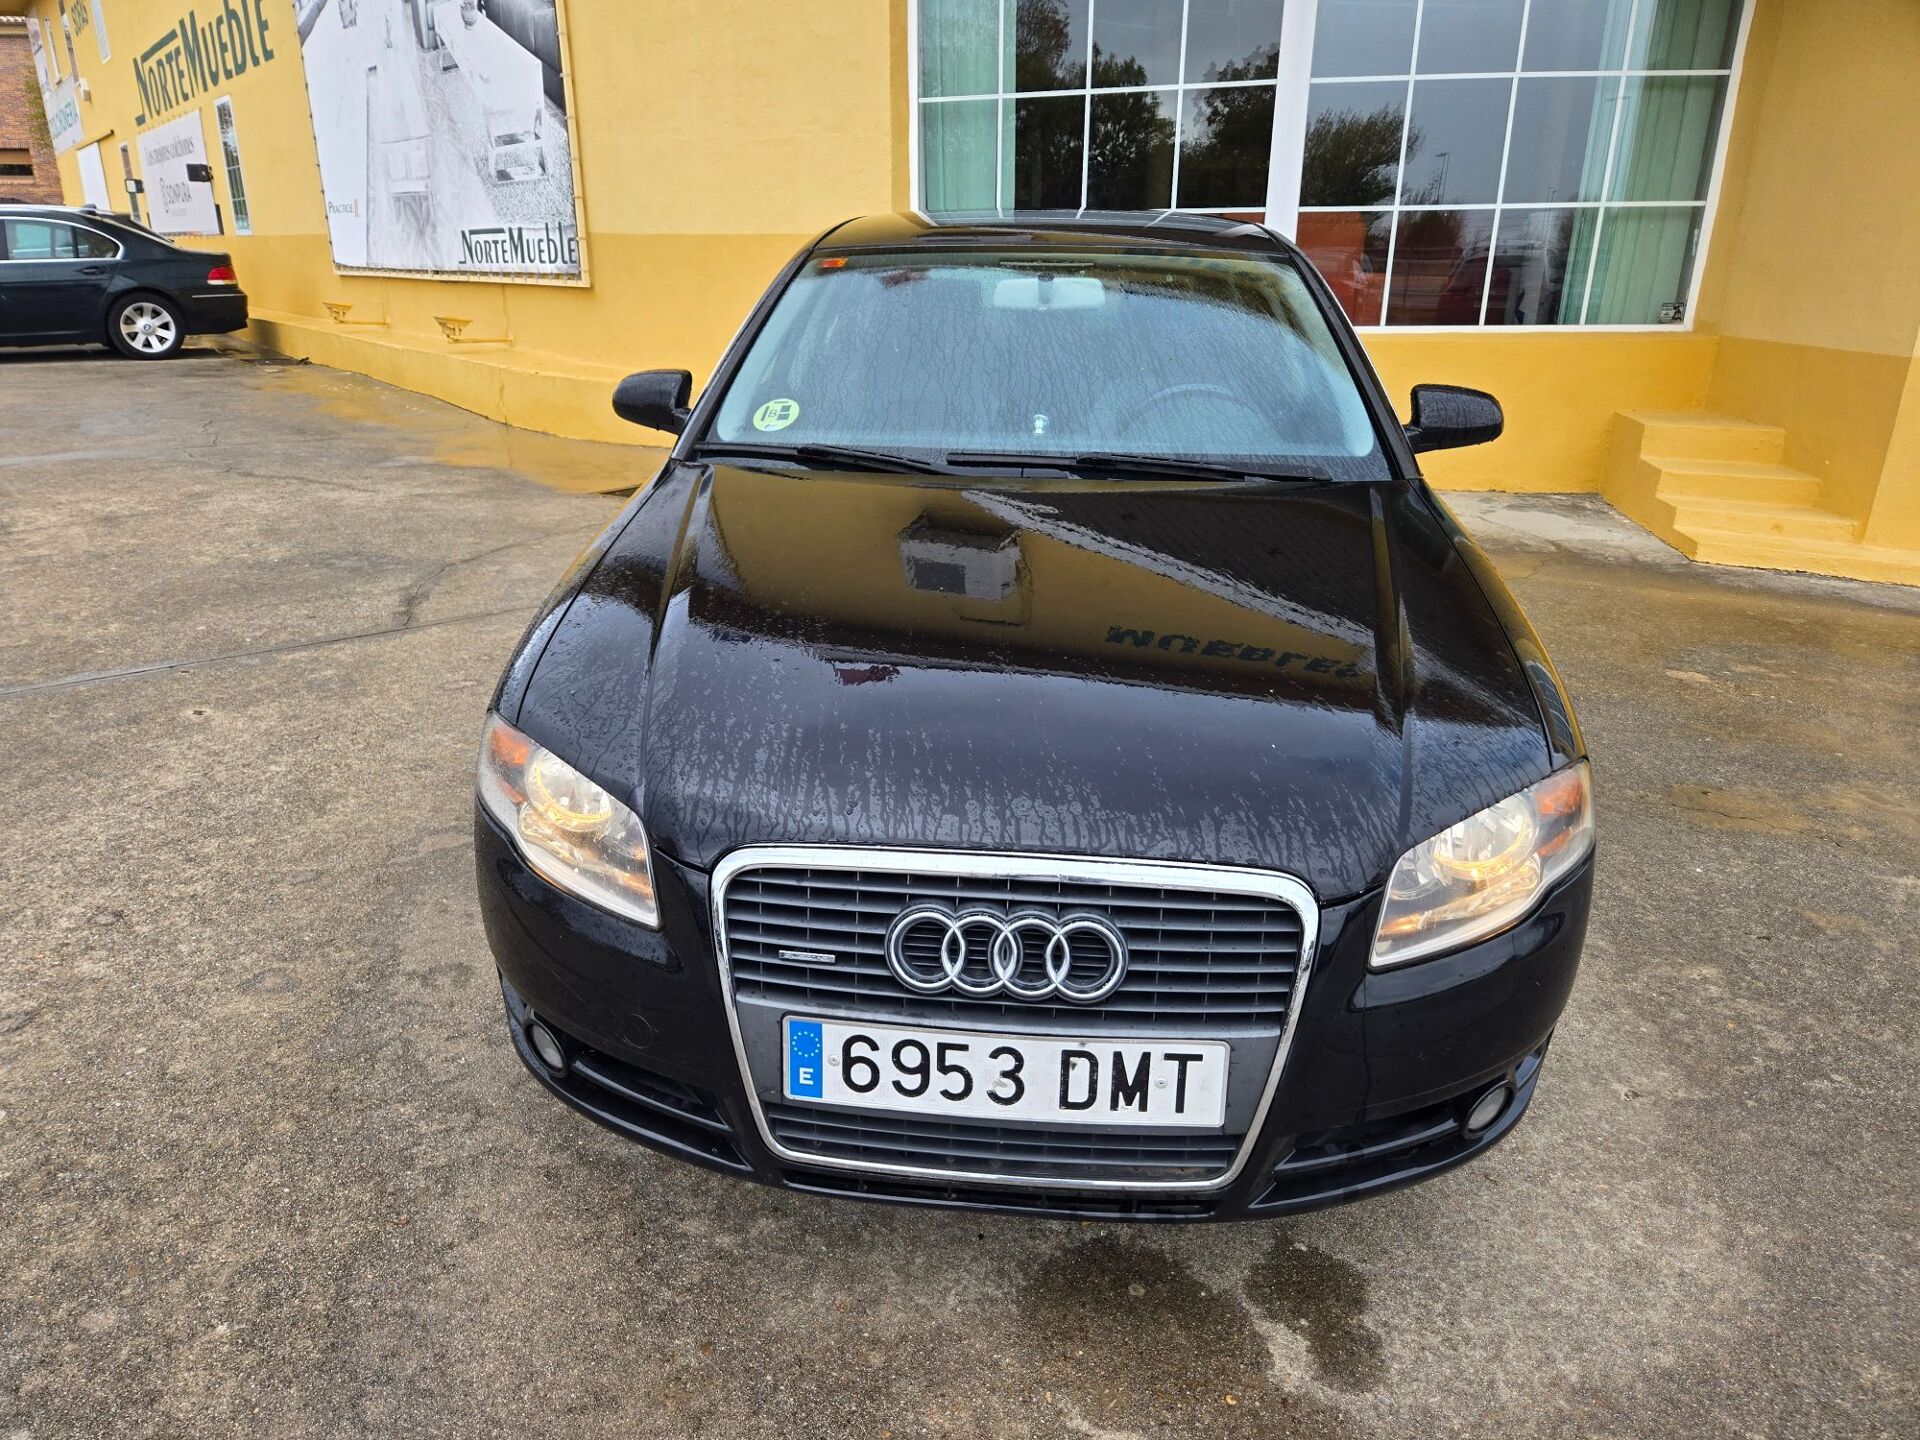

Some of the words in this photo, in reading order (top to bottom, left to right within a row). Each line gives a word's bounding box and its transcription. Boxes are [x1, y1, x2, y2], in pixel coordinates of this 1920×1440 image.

[799, 1067, 814, 1085] E
[842, 1034, 1025, 1106] 6953
[1059, 1049, 1203, 1113] DMT
